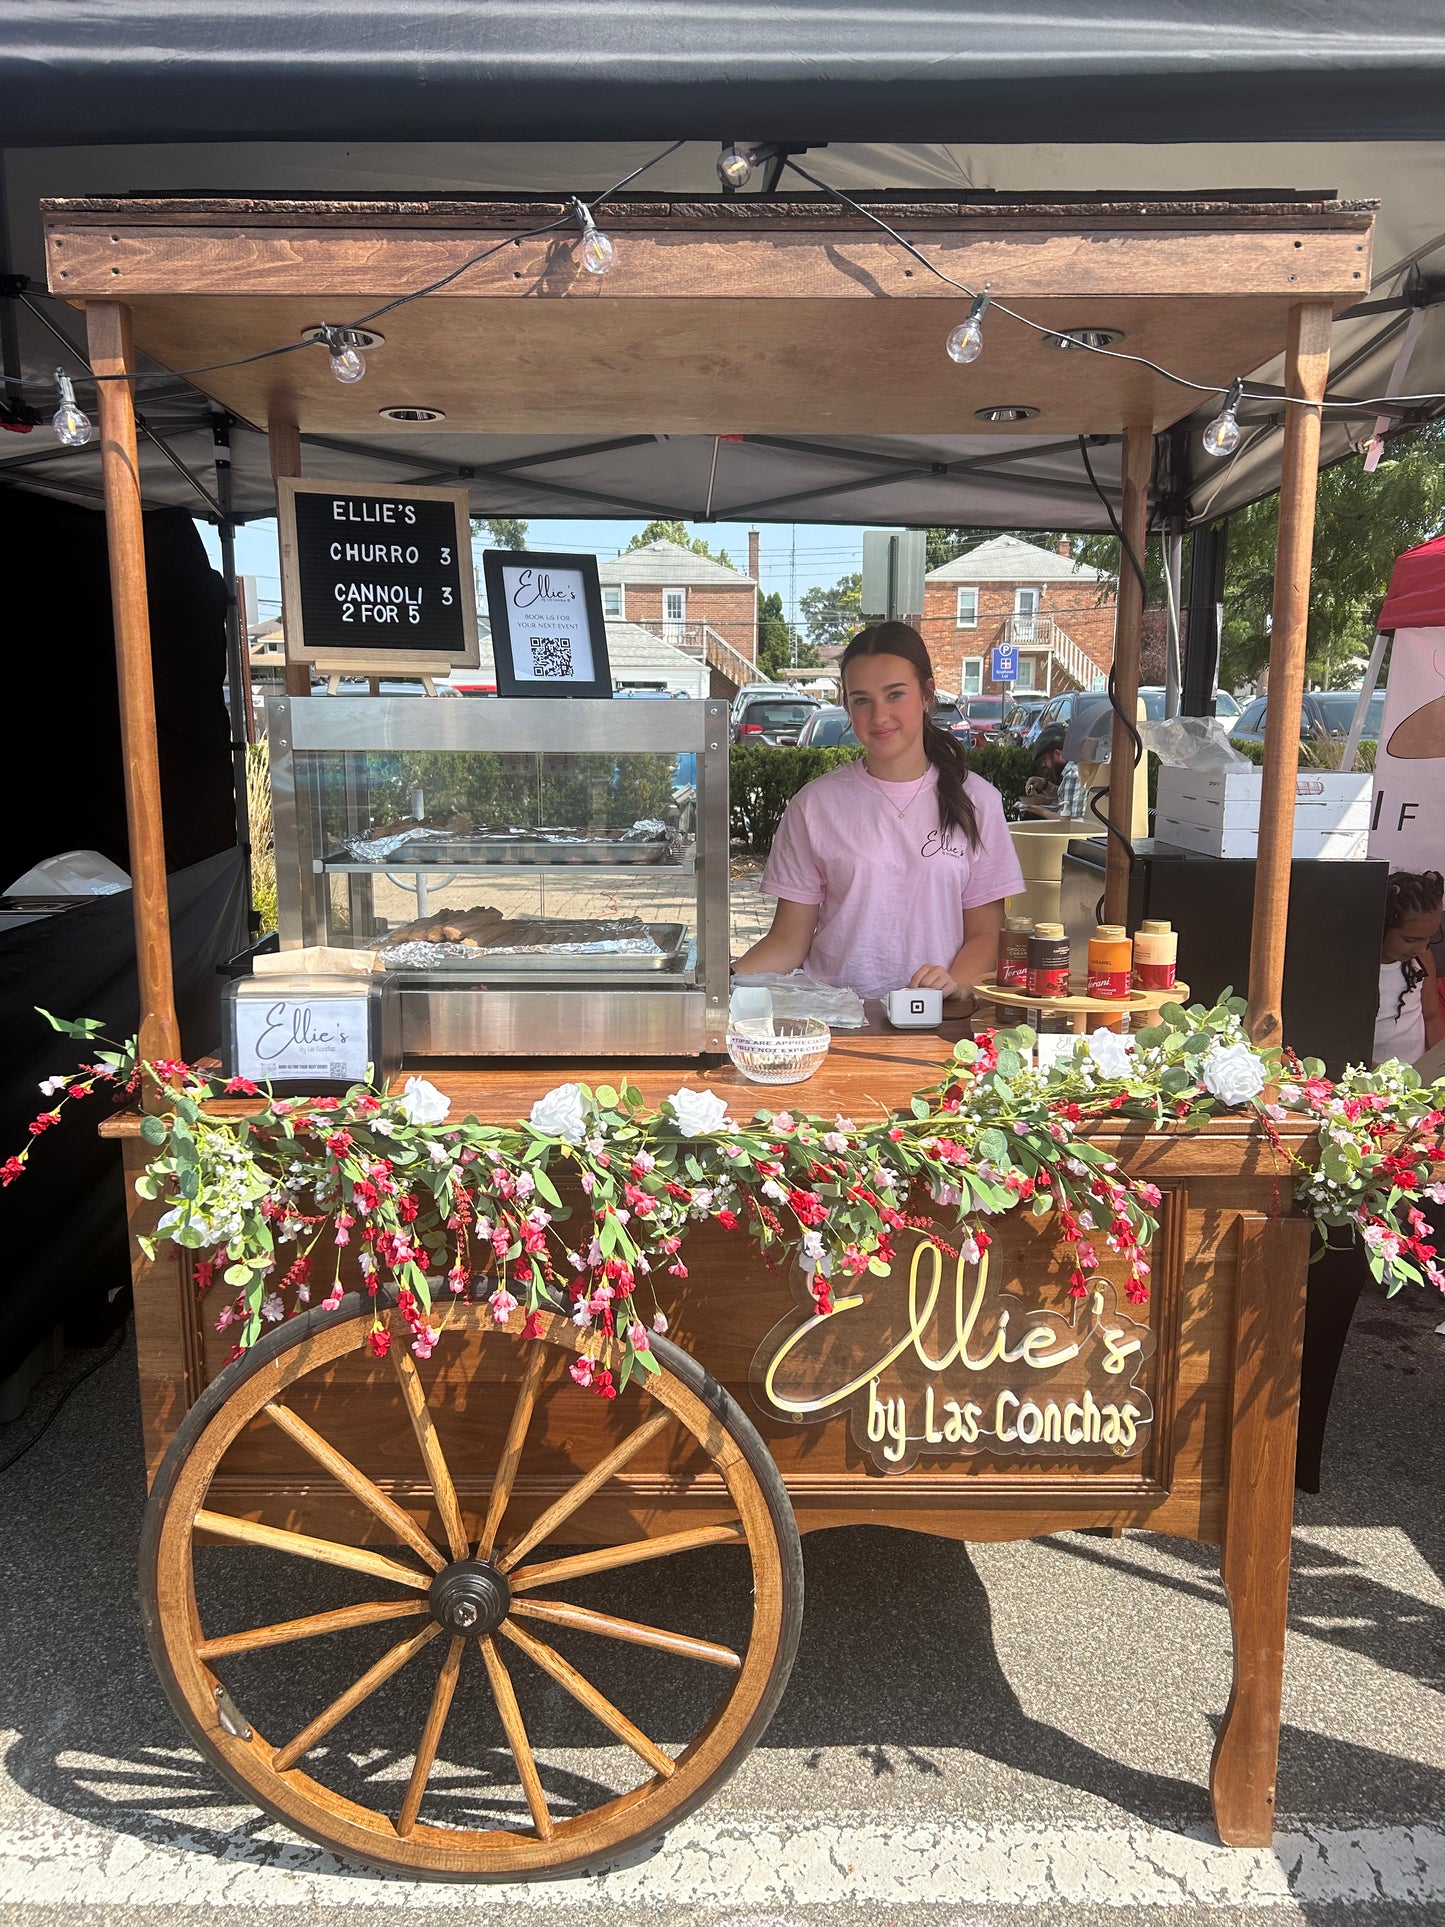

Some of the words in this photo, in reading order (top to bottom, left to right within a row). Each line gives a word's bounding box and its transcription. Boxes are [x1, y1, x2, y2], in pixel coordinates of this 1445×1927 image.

[333, 501, 416, 524] ELLIE'S
[330, 543, 418, 564] CHURRO
[440, 547, 451, 565] 3
[335, 583, 422, 604] CANNOLI
[442, 587, 453, 605] 3
[514, 570, 576, 608] Ellie's
[342, 603, 354, 622] 2
[361, 605, 399, 623] FOR
[409, 606, 420, 624] 5
[921, 830, 965, 858] Ellie's
[1003, 965, 1028, 980] Toran
[255, 1002, 349, 1060] Ellie's
[766, 1239, 1142, 1413] Ellie's
[867, 1379, 906, 1462] by
[925, 1386, 983, 1444] Las
[996, 1389, 1141, 1446] Conchas
